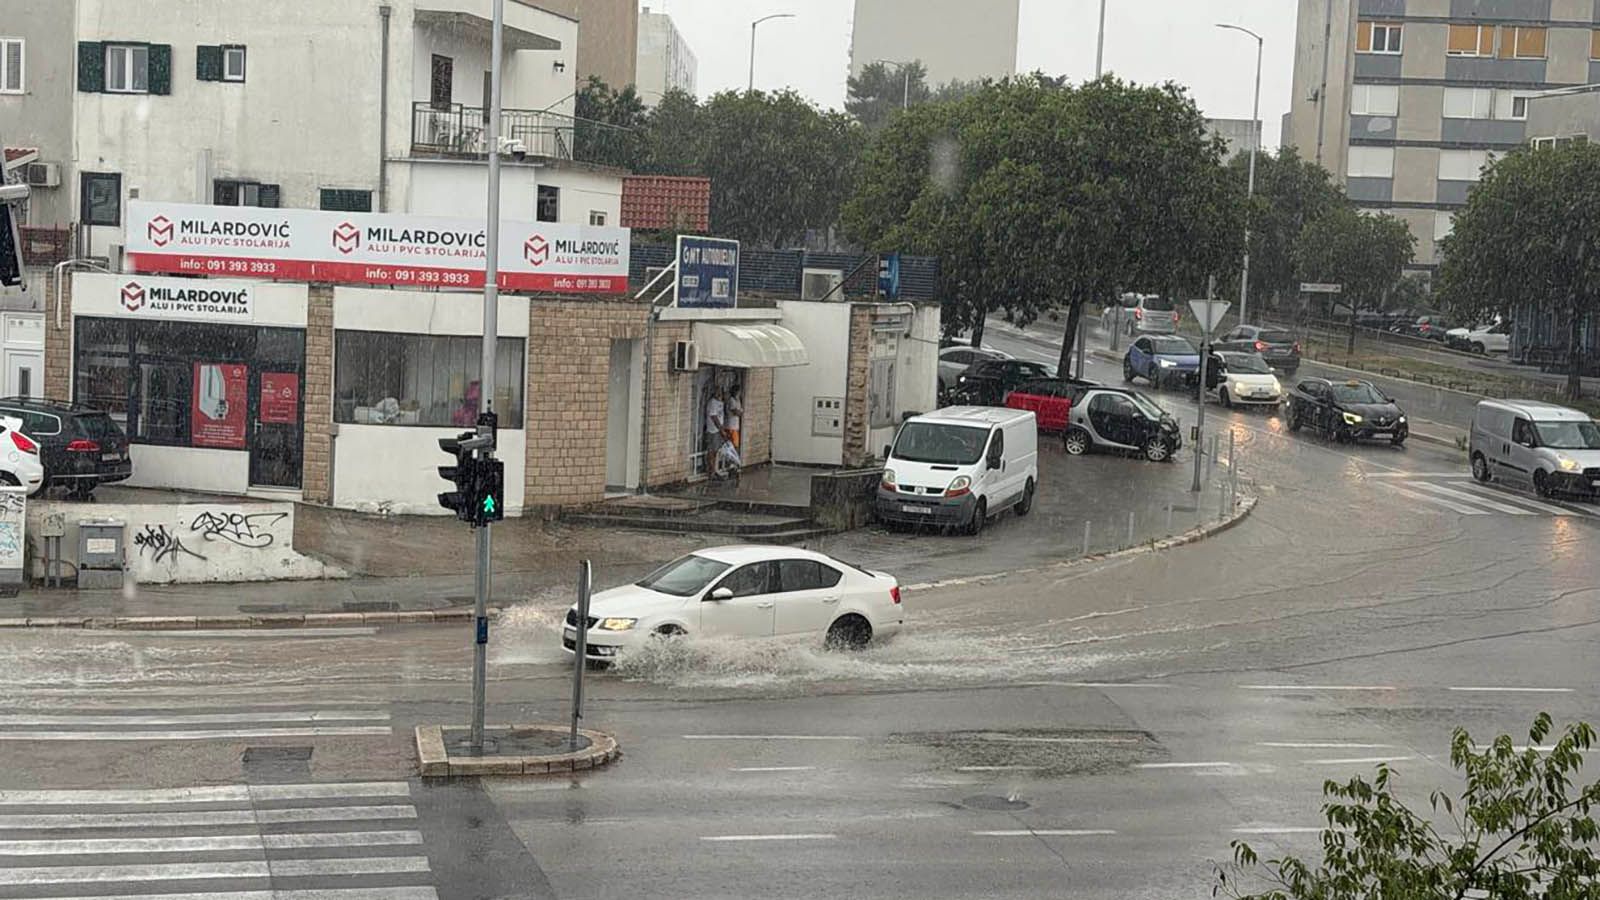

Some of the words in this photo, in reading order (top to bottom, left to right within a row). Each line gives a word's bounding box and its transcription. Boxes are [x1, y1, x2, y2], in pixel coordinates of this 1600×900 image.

[181, 220, 290, 238] MILARDOVIĆ
[181, 237, 201, 245] ALU
[210, 238, 230, 246] PVC
[233, 239, 291, 248] STOLARIJA
[368, 228, 485, 247] MILARDOVIĆ
[367, 244, 389, 252] ALU
[400, 246, 421, 254] PVC
[425, 247, 486, 258] STOLARIJA
[555, 239, 619, 255] MILARDOVIĆ
[180, 259, 204, 270] info:
[207, 260, 226, 271] 091
[229, 261, 248, 272] 393
[250, 262, 276, 273] 3933
[555, 256, 574, 264] ALU
[366, 268, 392, 279] info:
[395, 270, 415, 281] 091
[418, 271, 440, 282] 393
[443, 272, 470, 284] 3933
[554, 278, 575, 288] info:
[149, 287, 248, 304] MILARDOVIĆ
[197, 305, 248, 314] STOLARIJA
